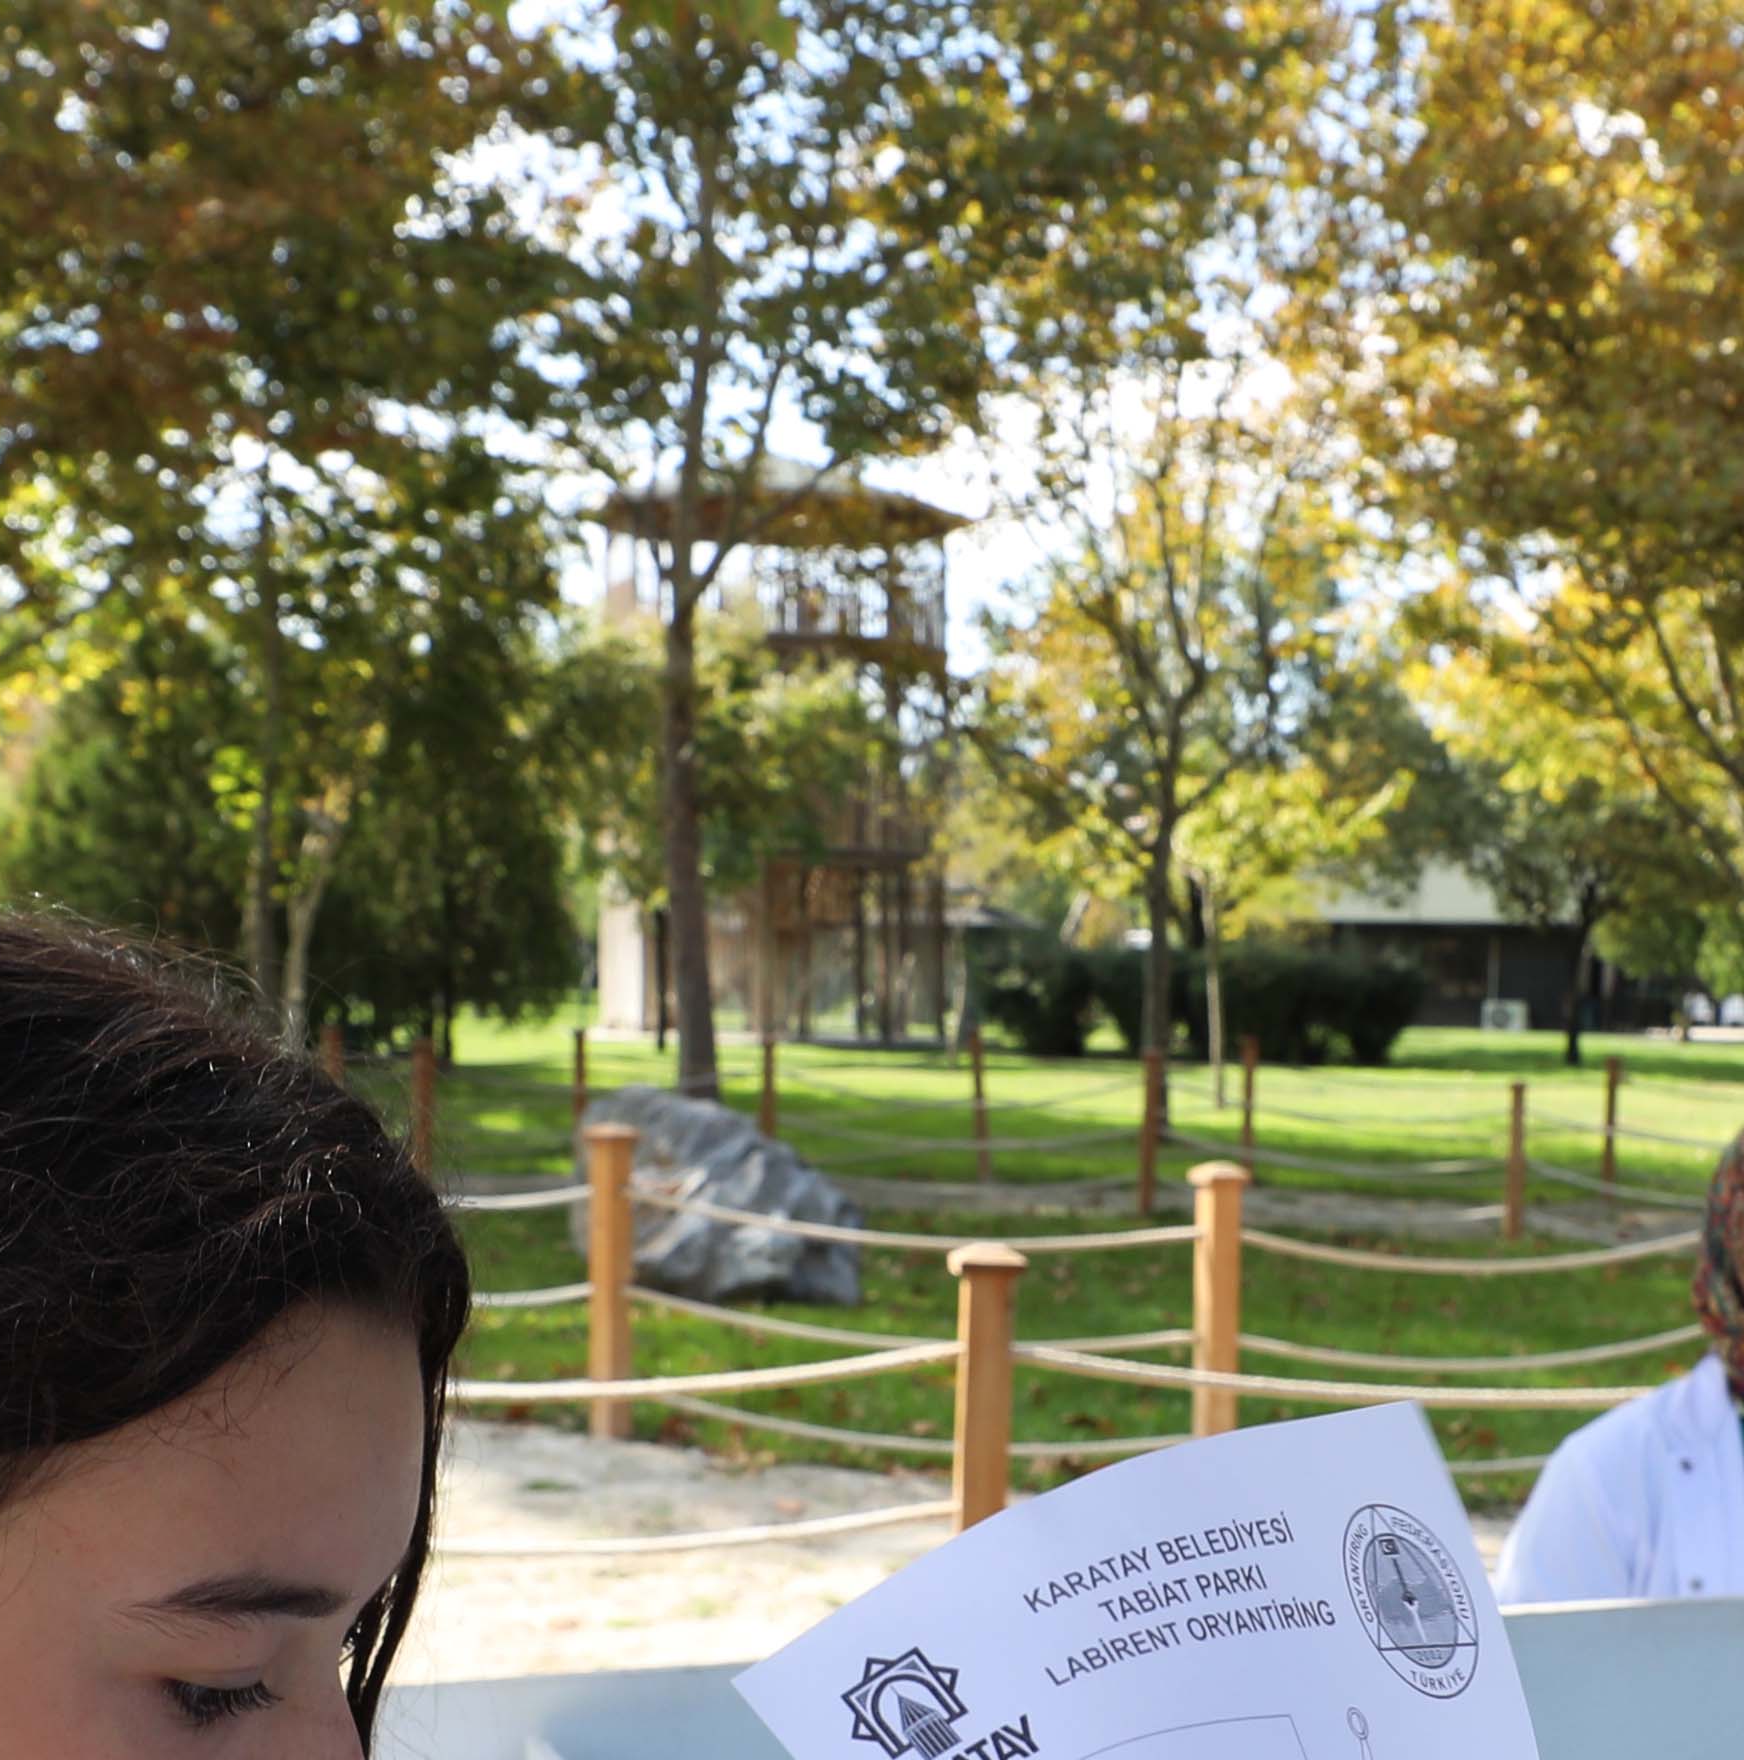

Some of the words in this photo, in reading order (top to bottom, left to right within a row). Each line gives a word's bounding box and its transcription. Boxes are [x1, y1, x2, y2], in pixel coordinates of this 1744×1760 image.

[1023, 1546, 1152, 1613] KARATAY
[1156, 1510, 1295, 1565] BELEDİYESİ
[1098, 1577, 1192, 1623] TABİAT
[1195, 1563, 1268, 1599] PARKI
[1045, 1621, 1182, 1687] LABİRENT
[1186, 1596, 1337, 1642] ORYANTİRİNG
[1410, 1667, 1466, 1692] TÜRKİYE
